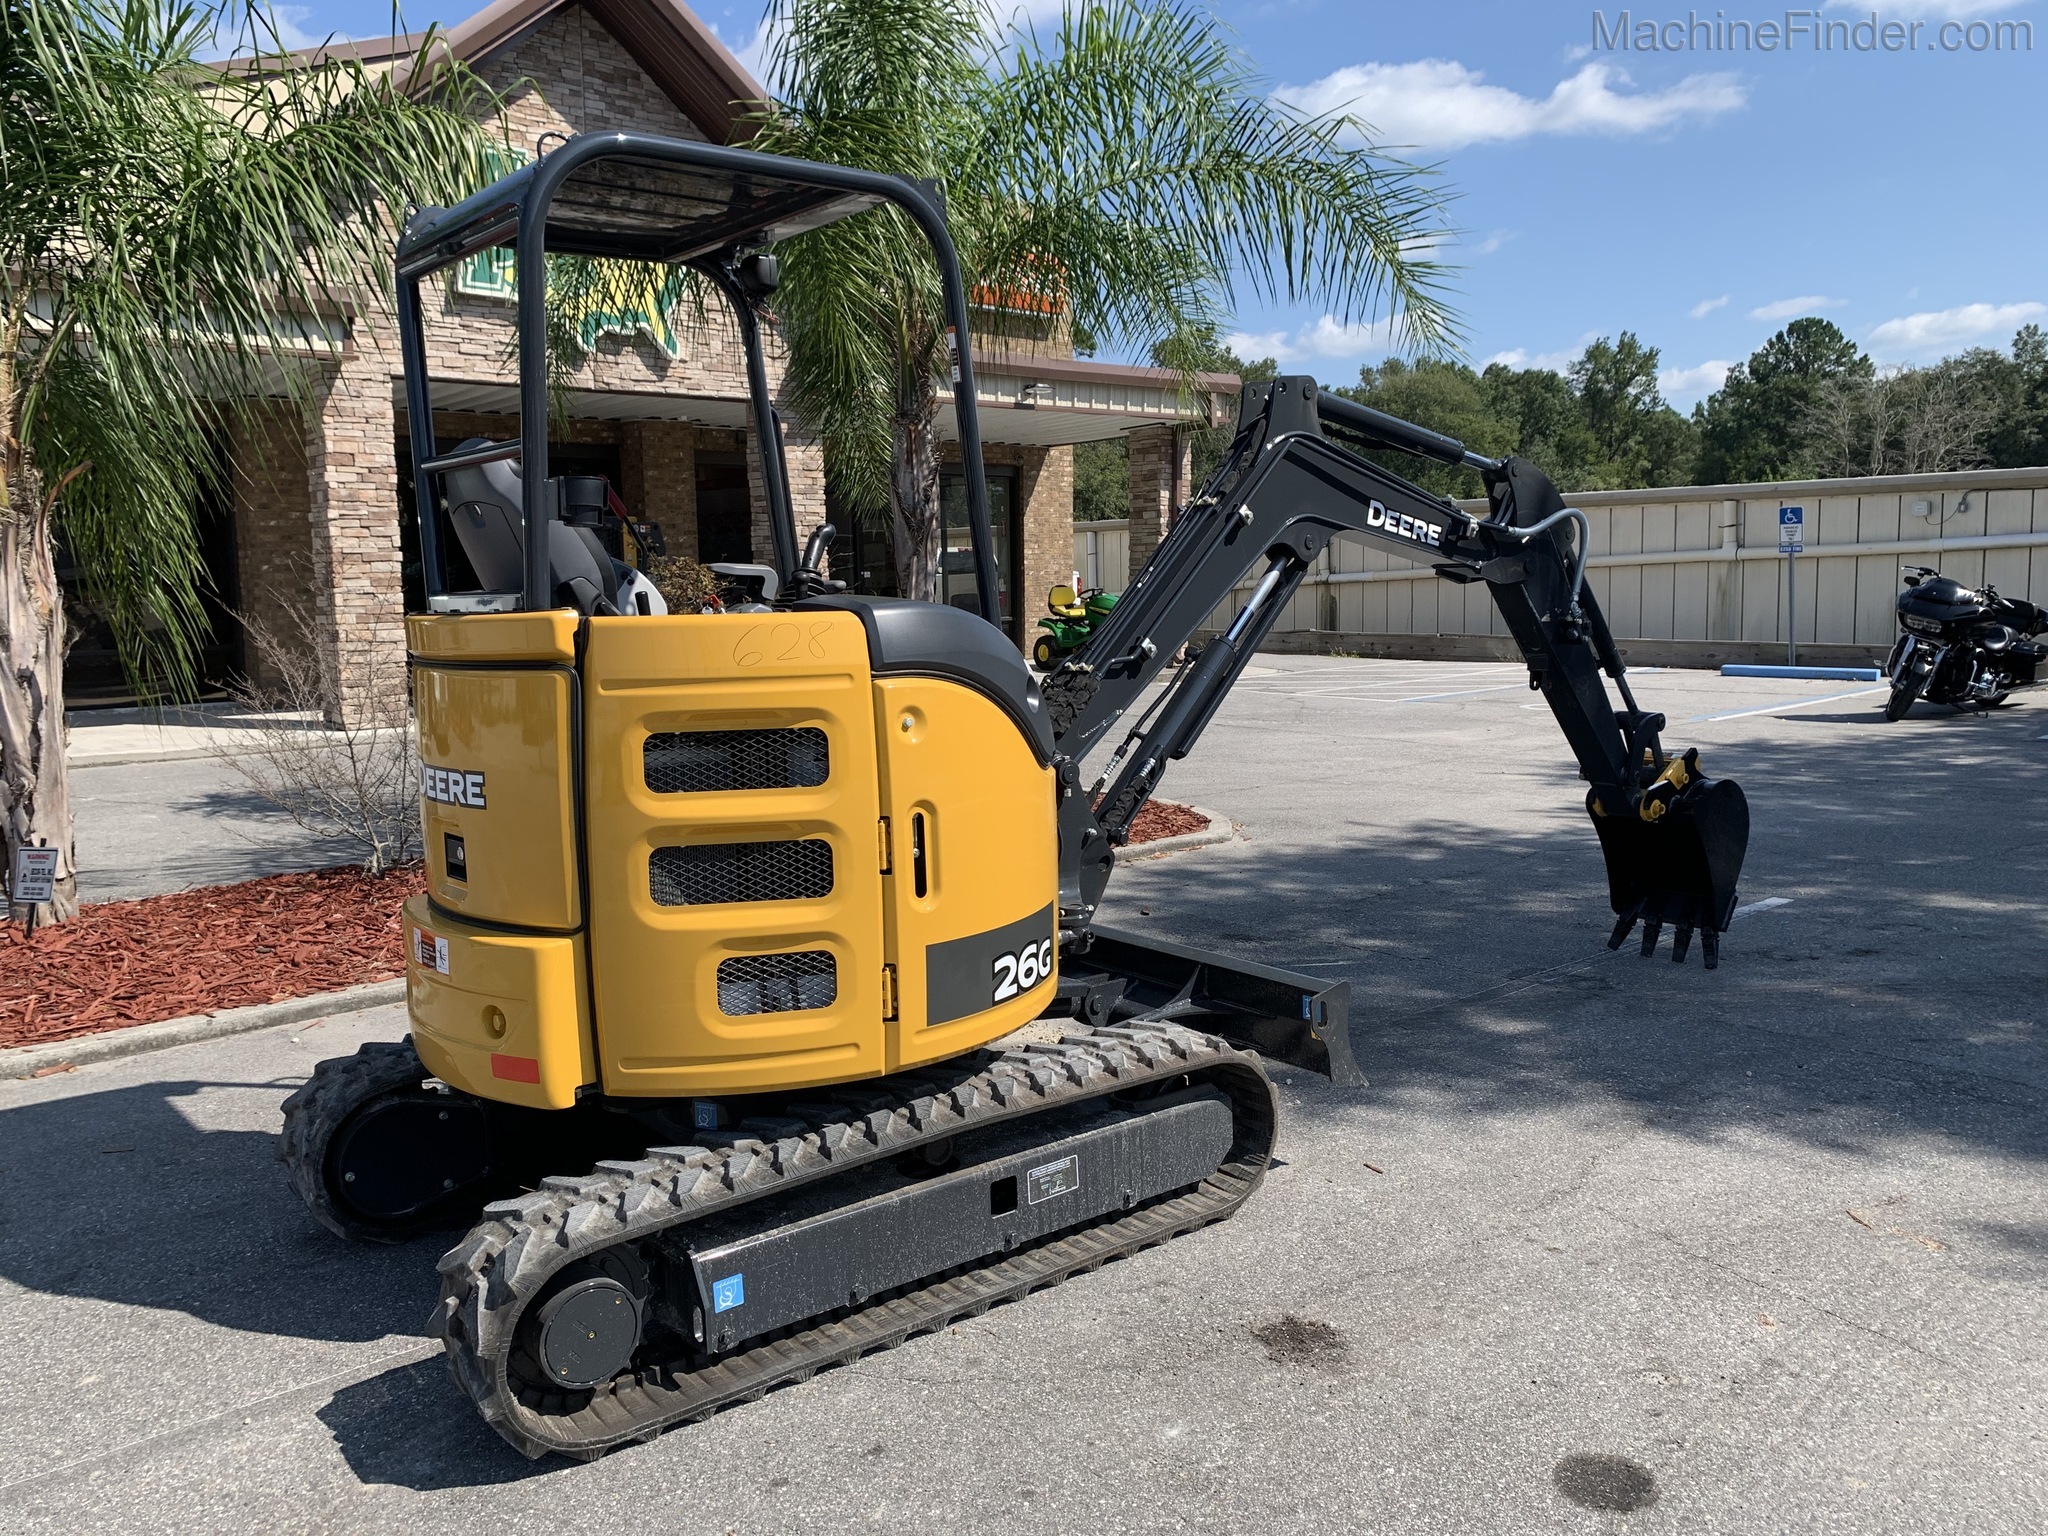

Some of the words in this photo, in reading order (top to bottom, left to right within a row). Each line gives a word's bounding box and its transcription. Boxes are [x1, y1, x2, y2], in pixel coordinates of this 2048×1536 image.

[1366, 499, 1442, 547] DEERE
[732, 620, 835, 668] 628
[993, 937, 1051, 1002] 26G
